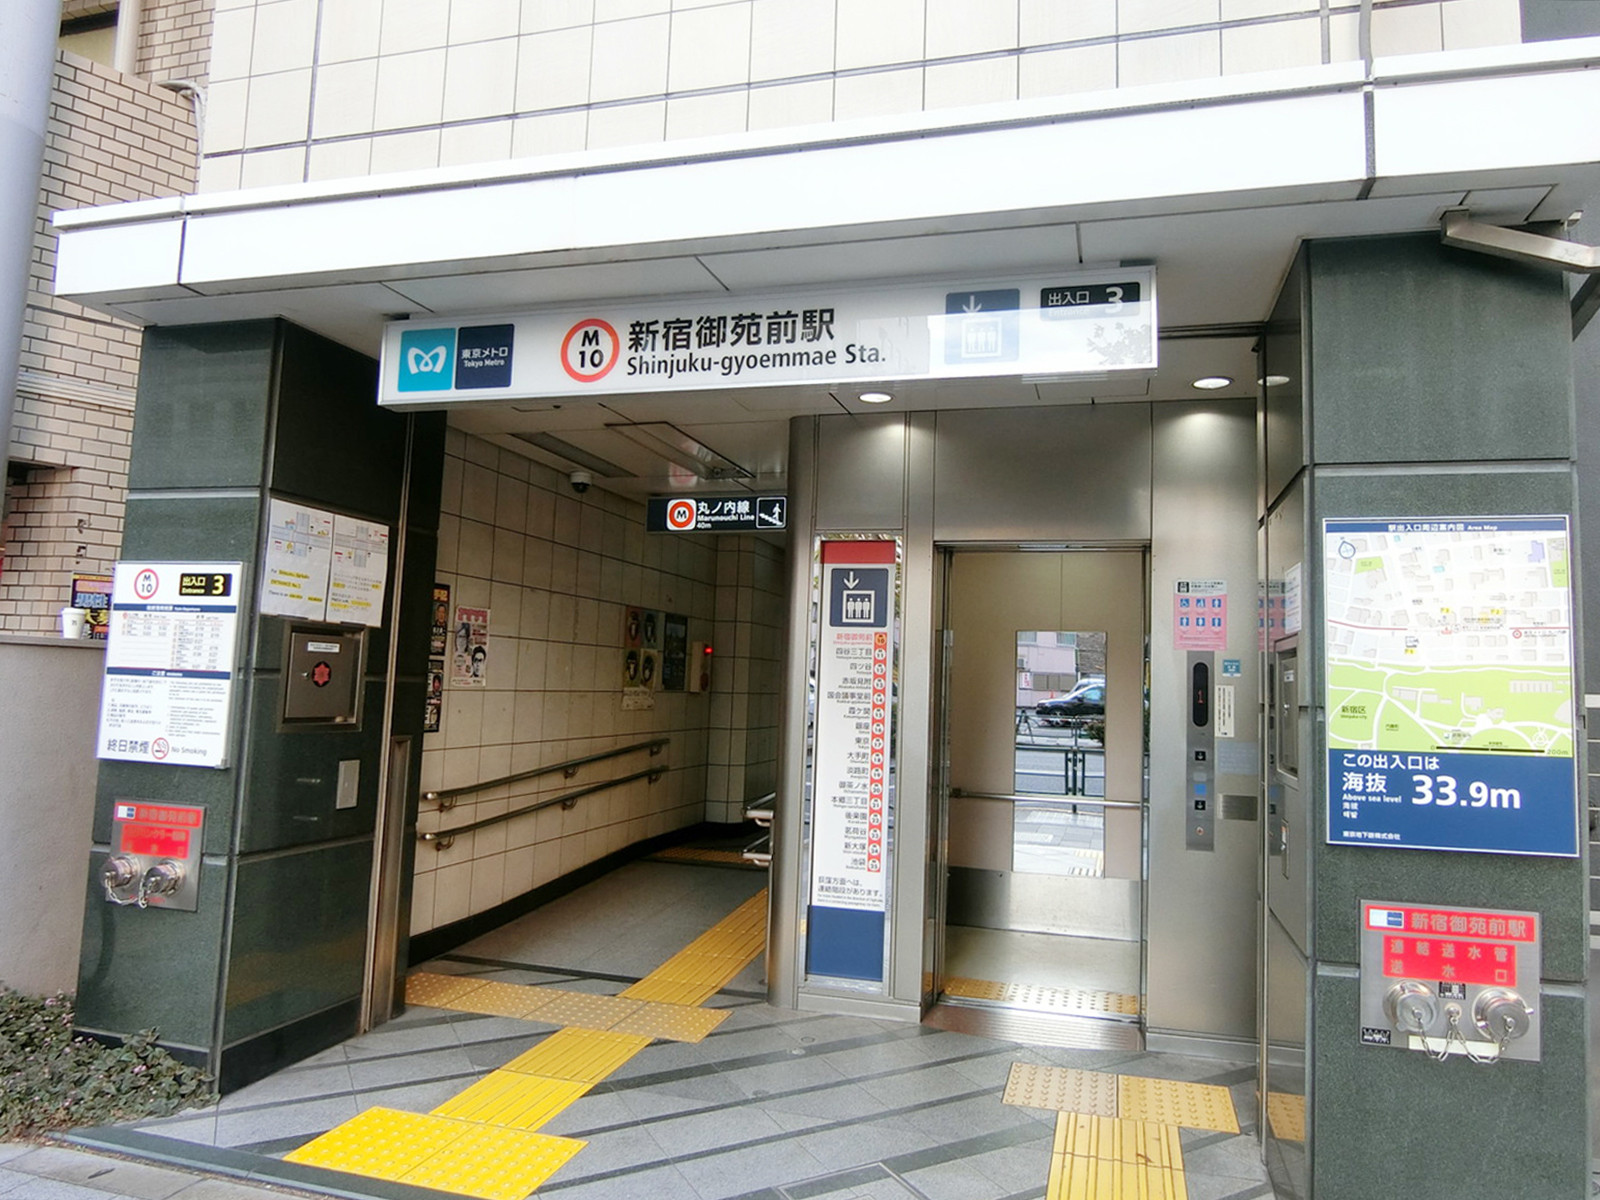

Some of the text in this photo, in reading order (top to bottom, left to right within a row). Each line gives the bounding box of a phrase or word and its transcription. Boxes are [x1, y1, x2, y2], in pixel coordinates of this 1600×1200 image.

[1048, 286, 1124, 314] 出入口 3
[581, 330, 600, 347] M
[628, 308, 835, 353] 新宿御苑前駅
[461, 346, 509, 359] 東京メトロ
[579, 349, 604, 368] 10
[627, 343, 886, 379] Shinjuku-gyoemmae Sta.
[697, 500, 750, 514] 丸ノ内線
[142, 574, 152, 582] M
[182, 575, 225, 595] 出入口 3
[141, 583, 153, 593] 10
[107, 739, 150, 754] 終日禁煙
[181, 746, 207, 757] Smoking
[1343, 753, 1440, 771] この出入口は
[1342, 771, 1521, 810] 海抜 33.9m
[1342, 793, 1367, 802] Above
[1383, 795, 1402, 803] level
[1411, 912, 1527, 938] 新宿御苑前駅
